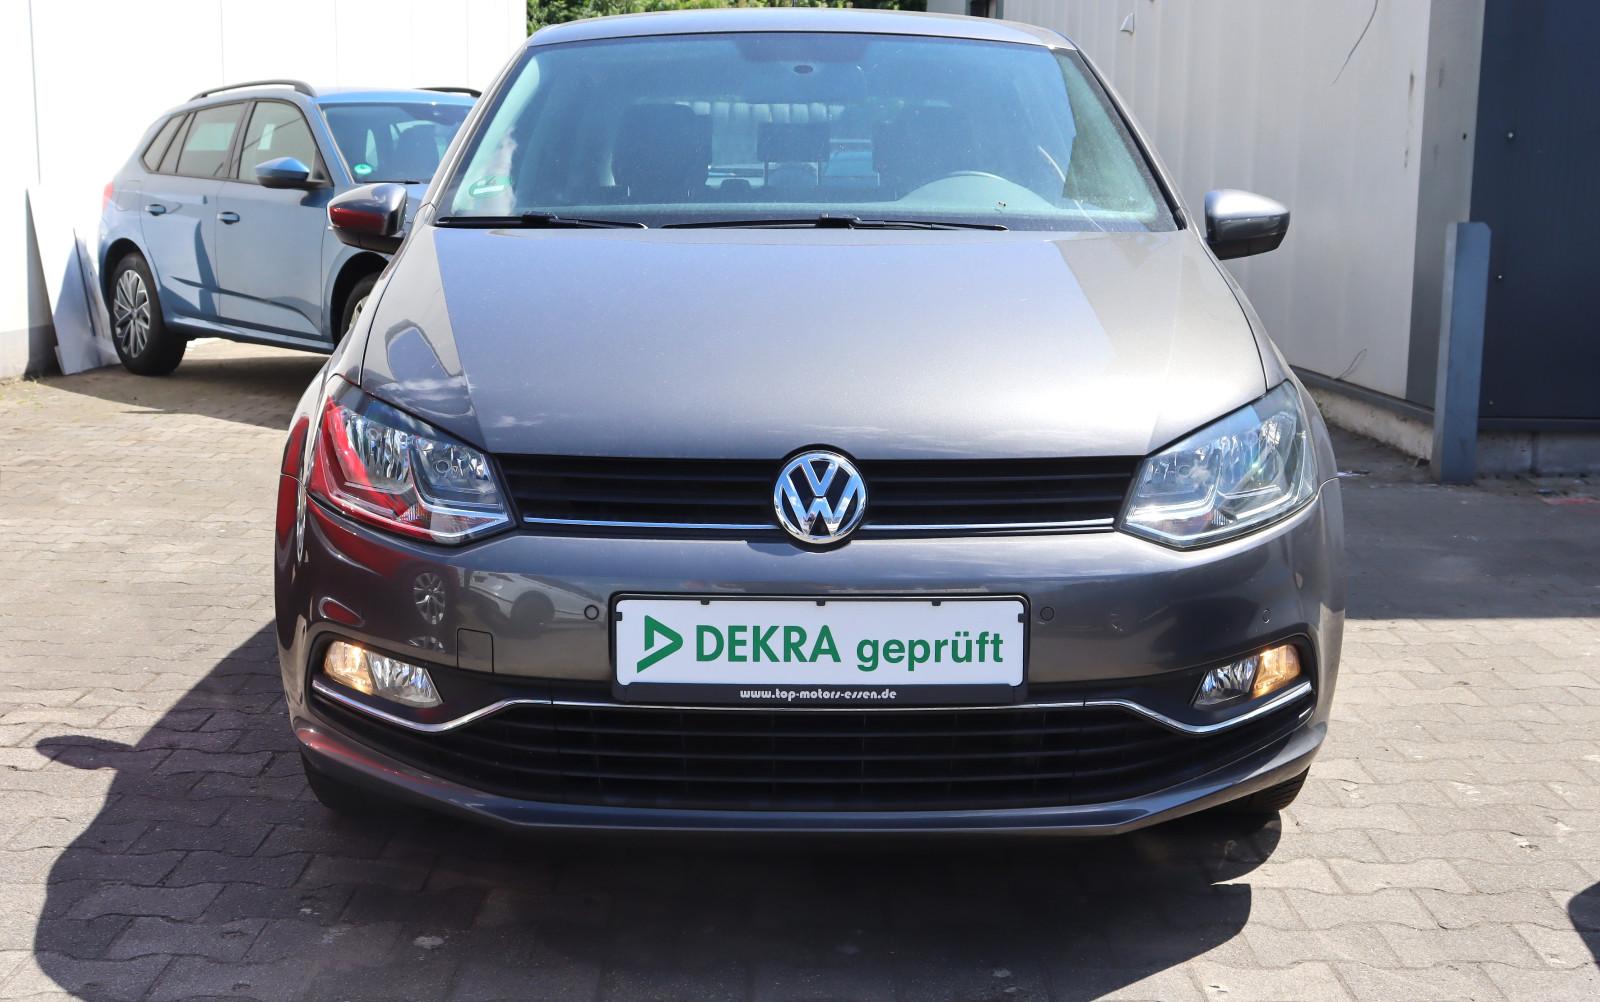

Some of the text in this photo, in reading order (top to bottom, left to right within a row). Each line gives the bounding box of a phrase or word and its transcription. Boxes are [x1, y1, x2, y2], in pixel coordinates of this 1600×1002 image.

[695, 624, 1003, 672] DEKRA geprüft
[740, 688, 897, 702] www.top-motors-essen.de
